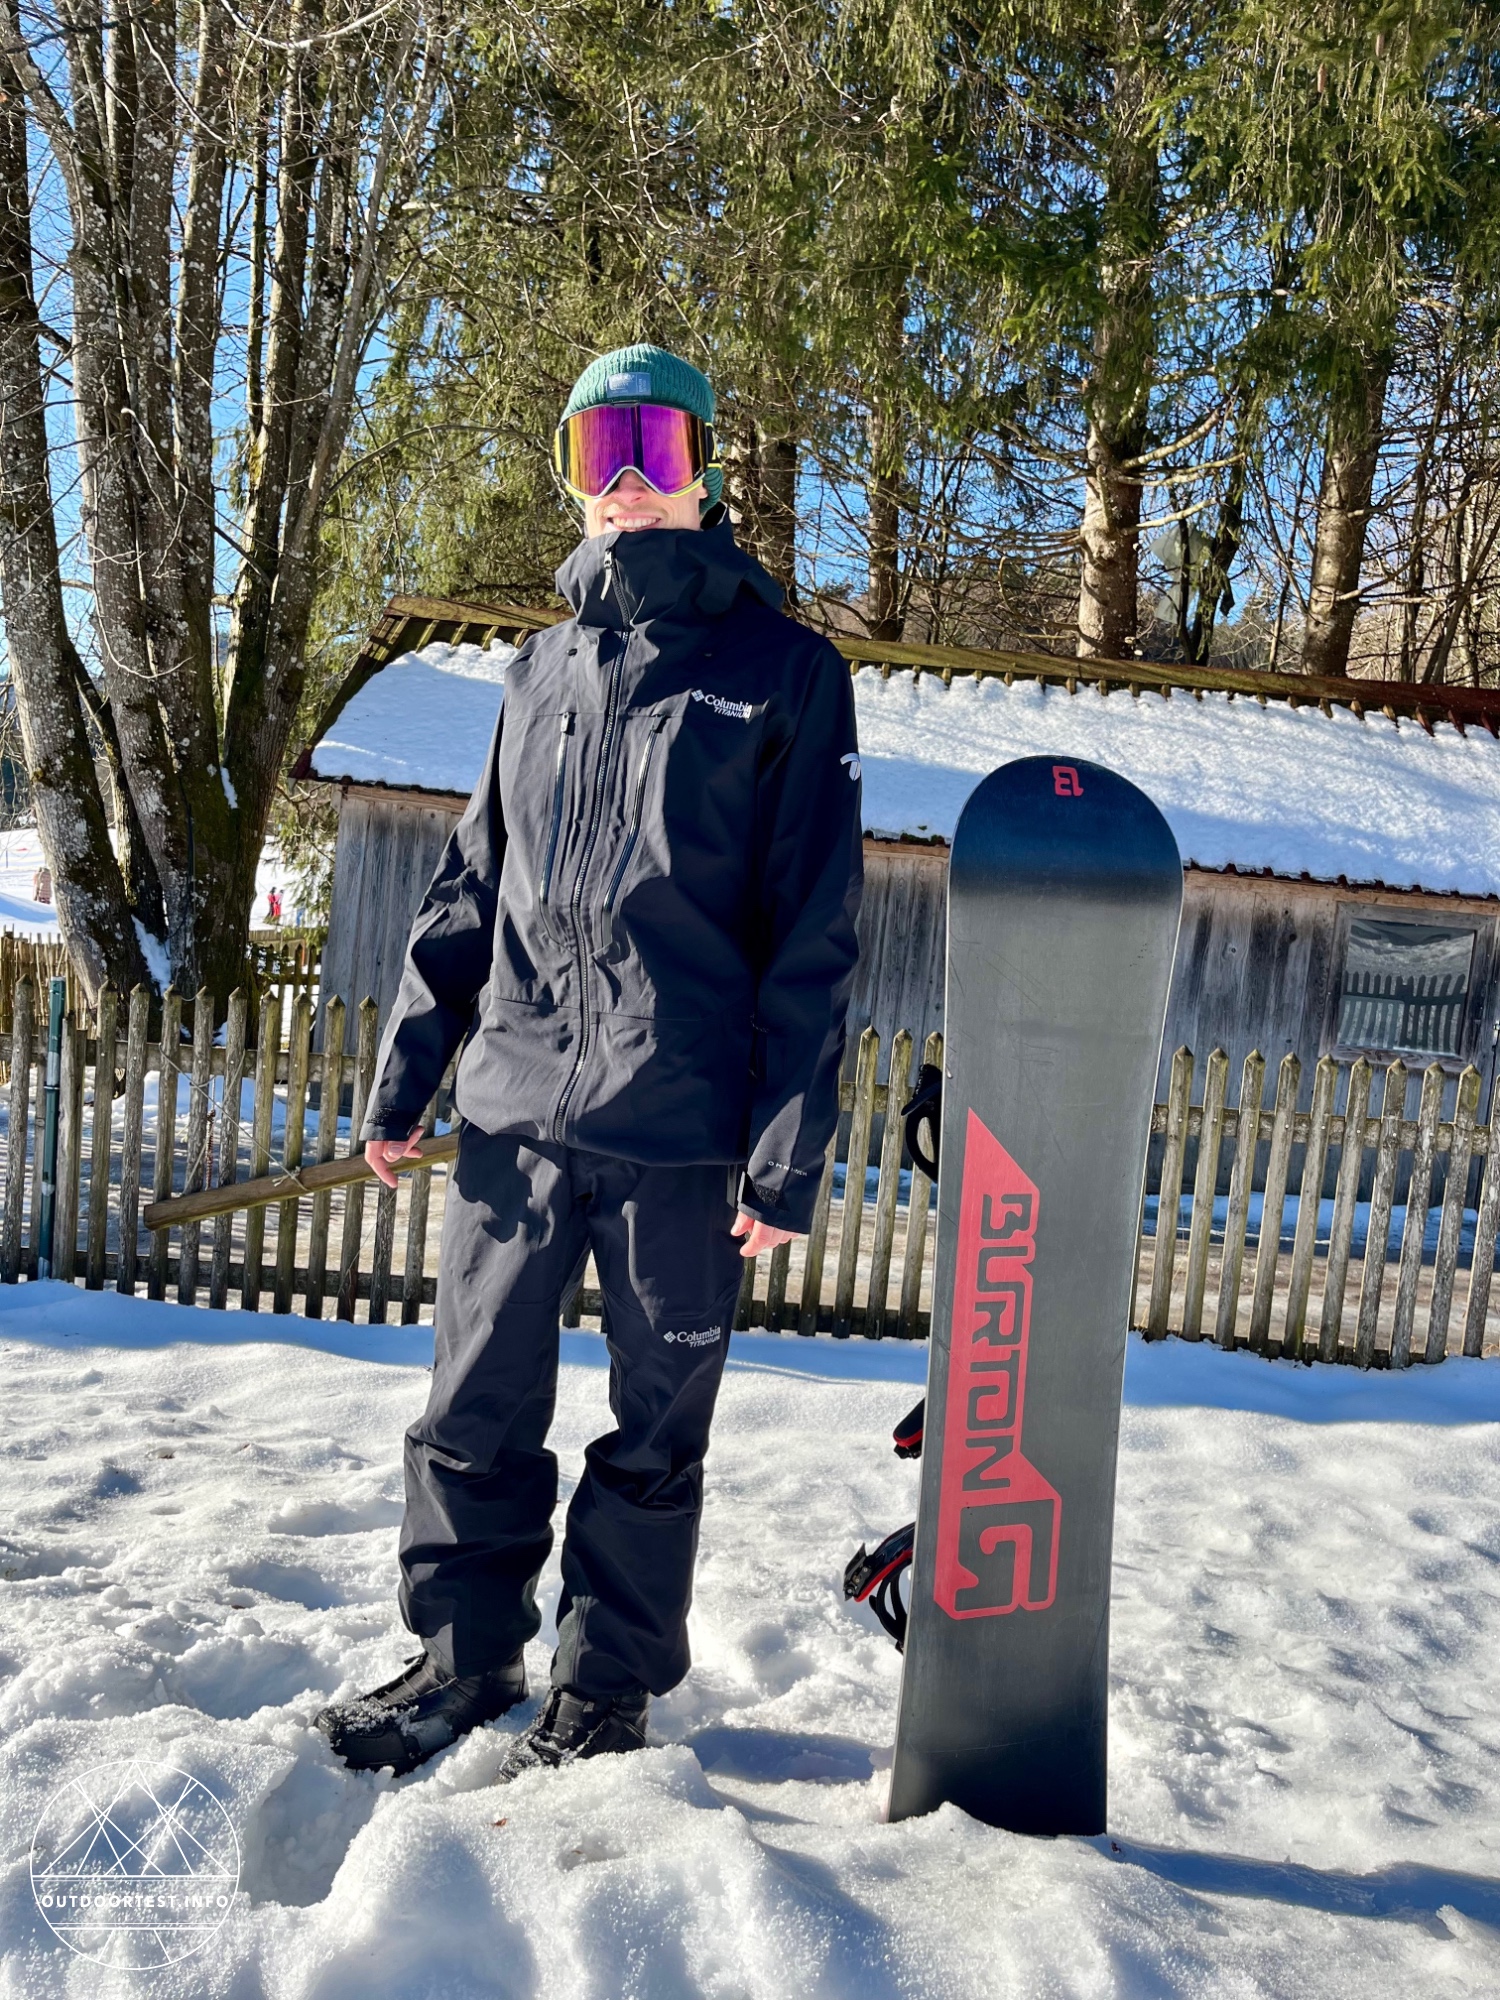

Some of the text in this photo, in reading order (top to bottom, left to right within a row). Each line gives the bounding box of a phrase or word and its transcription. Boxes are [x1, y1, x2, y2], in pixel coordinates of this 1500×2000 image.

[704, 694, 752, 713] Columbia
[714, 706, 750, 719] TITANIUM
[676, 1325, 721, 1343] Columbia
[689, 1334, 721, 1348] TITANIUM
[961, 1193, 1034, 1492] BURTON
